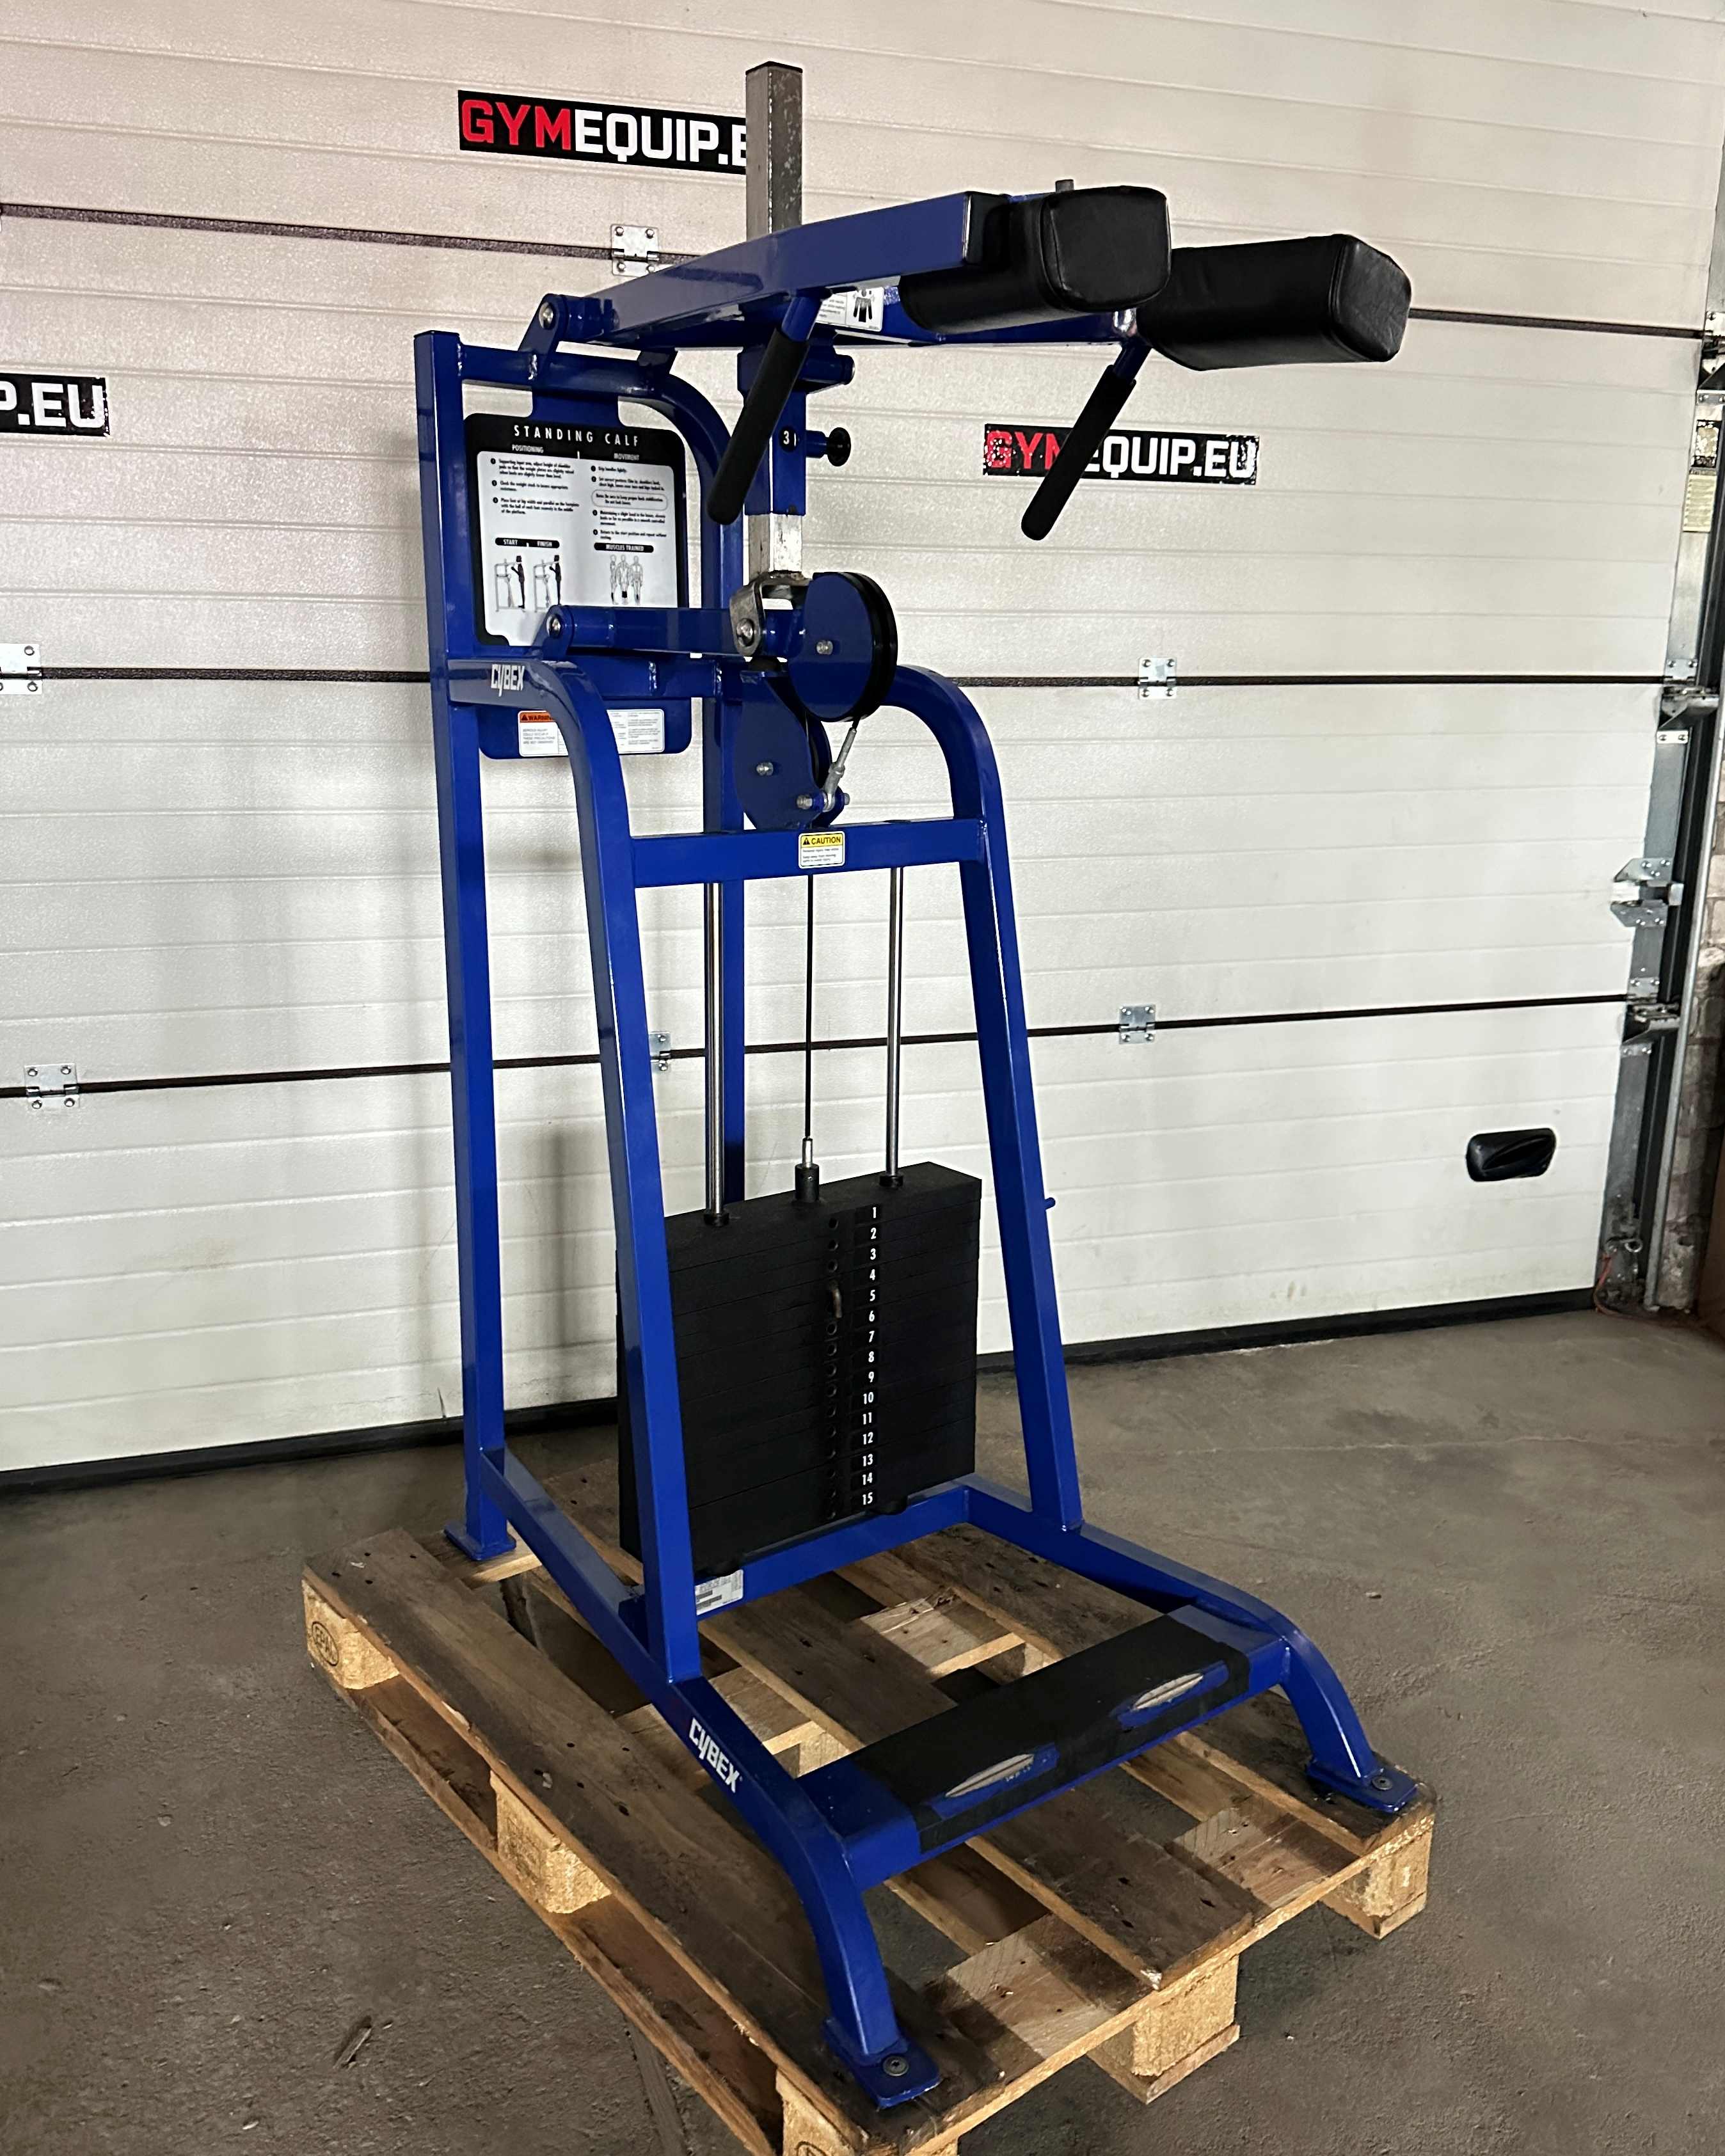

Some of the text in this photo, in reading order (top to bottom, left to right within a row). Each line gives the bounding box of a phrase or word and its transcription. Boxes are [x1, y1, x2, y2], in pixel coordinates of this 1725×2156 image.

[0, 380, 105, 428] P.EU
[514, 424, 638, 447] STANDING CALF
[512, 444, 544, 453] POSITIONING
[491, 664, 525, 697] CYBEX
[811, 836, 841, 845] CAUTION
[872, 1207, 877, 1219] 1
[870, 1227, 877, 1240] 2
[870, 1248, 877, 1260] 3
[870, 1269, 876, 1281] 4
[870, 1289, 876, 1302] 5
[868, 1310, 875, 1322] 6
[868, 1330, 875, 1343] 7
[868, 1351, 875, 1363] 8
[868, 1371, 875, 1383] 9
[863, 1391, 874, 1405] 10
[862, 1412, 872, 1425] 11
[862, 1432, 873, 1445] 12
[862, 1454, 873, 1467] 13
[862, 1472, 873, 1486] 14
[862, 1492, 873, 1505] 15
[688, 1717, 740, 1793] CYBEX
